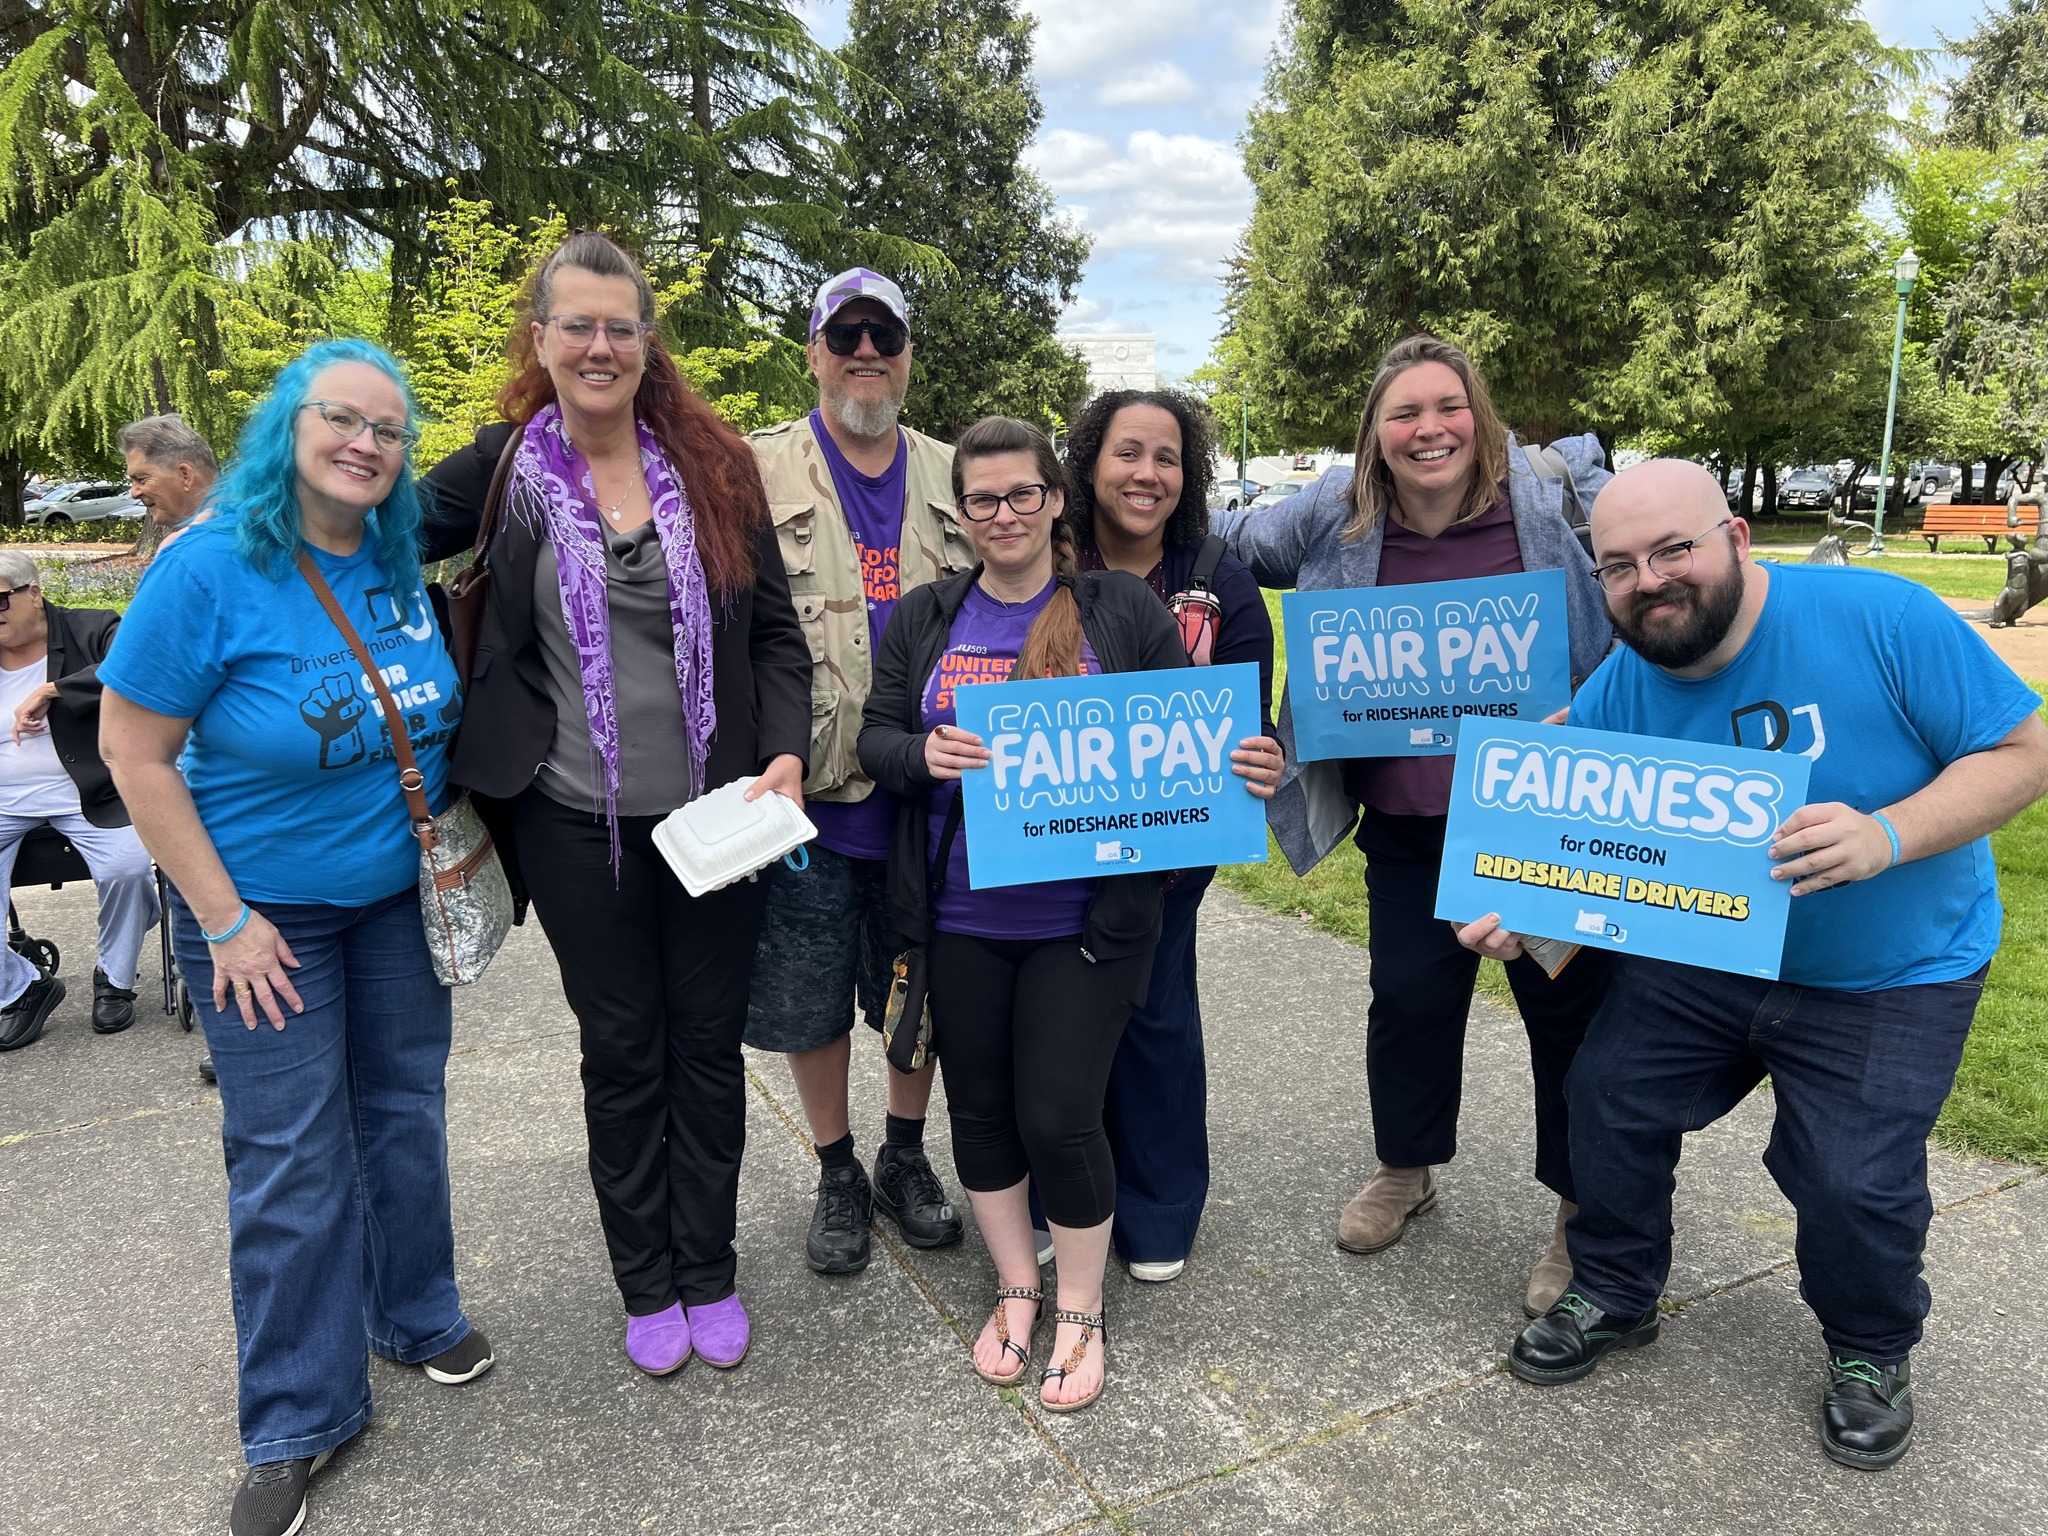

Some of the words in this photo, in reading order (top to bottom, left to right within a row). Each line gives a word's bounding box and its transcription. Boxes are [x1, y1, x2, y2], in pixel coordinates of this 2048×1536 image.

[291, 647, 357, 674] Drivers
[364, 634, 408, 657] nion
[1312, 630, 1428, 684] FAIR
[1437, 619, 1540, 677] PAY
[380, 712, 427, 743] FR
[1342, 709, 1363, 723] for
[1365, 705, 1450, 722] RIDESHARE
[1452, 702, 1519, 718] DRIVERS
[990, 727, 1117, 790] FAIR
[1129, 716, 1233, 779] PAY
[1482, 747, 1774, 838] FAIRNESS
[1022, 821, 1046, 838] for
[1049, 812, 1140, 835] RIDESHARE
[1141, 806, 1210, 828] DRIVERS
[1560, 834, 1586, 853] for
[1589, 838, 1667, 867] OREGON
[1473, 853, 1622, 901] RIDESHARE
[1624, 877, 1750, 922] DRIVERS
